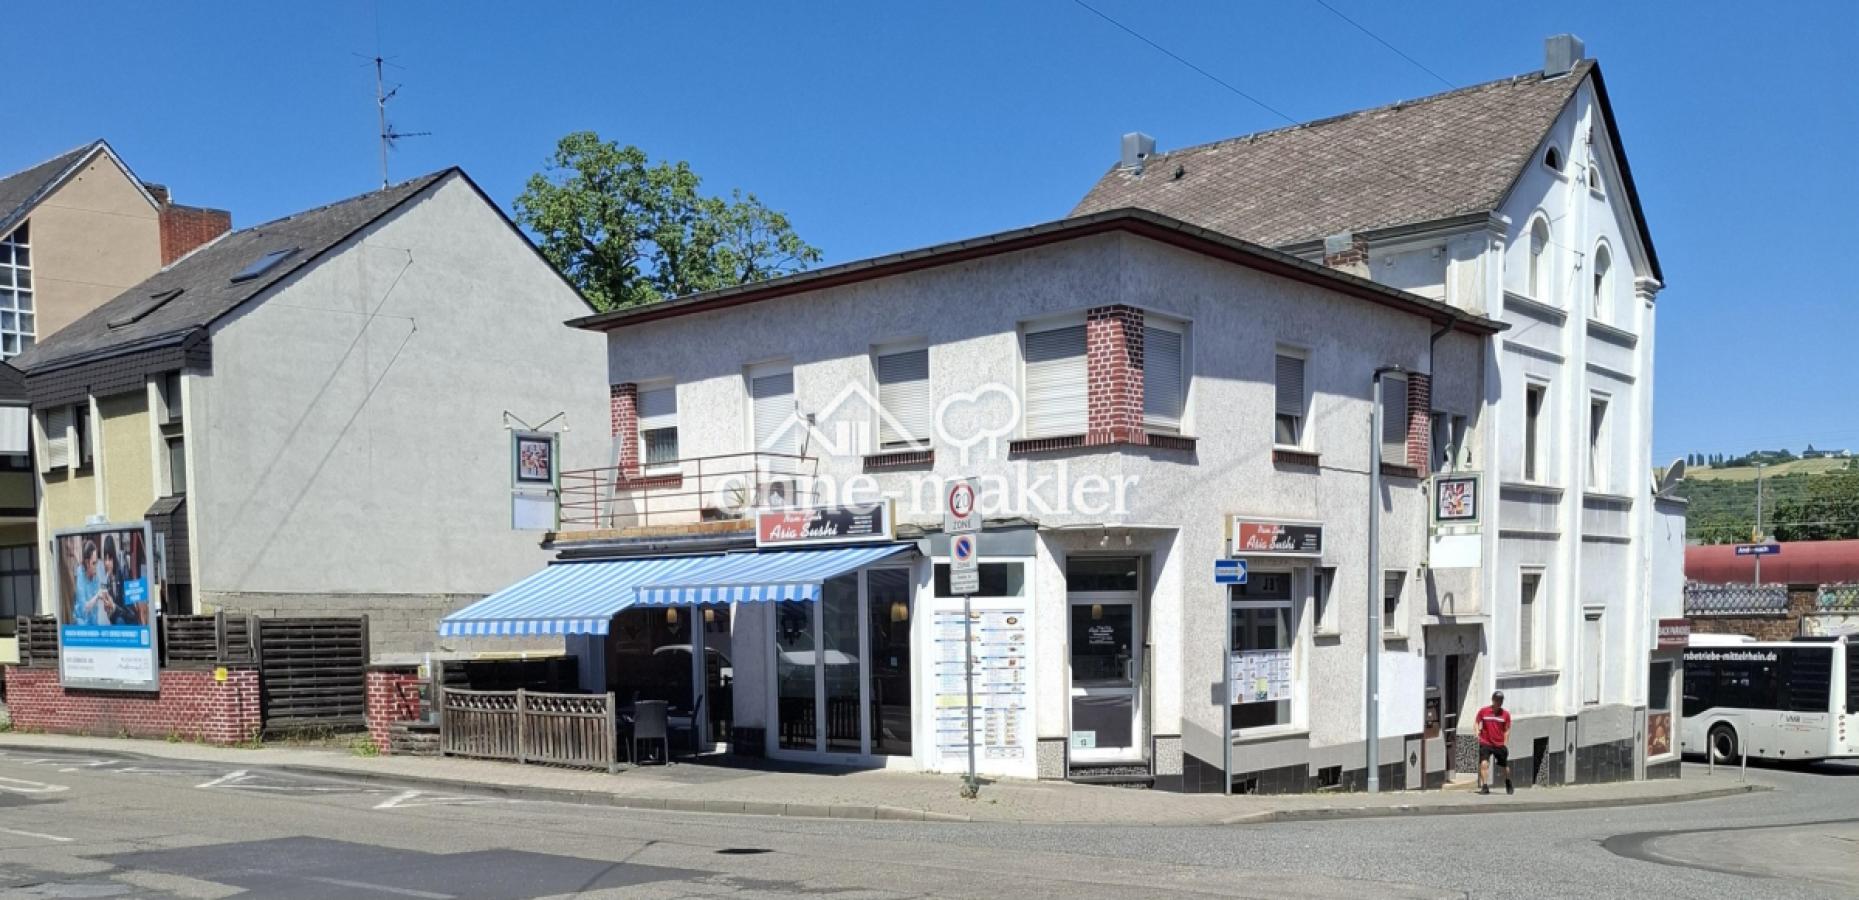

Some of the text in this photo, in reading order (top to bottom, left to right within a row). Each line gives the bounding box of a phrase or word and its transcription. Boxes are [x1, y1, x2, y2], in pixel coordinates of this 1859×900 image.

[954, 492, 969, 510] 20
[769, 524, 798, 541] Asia
[800, 520, 839, 538] Sushi
[953, 519, 972, 530] ZONE
[1269, 534, 1296, 550] Sushi
